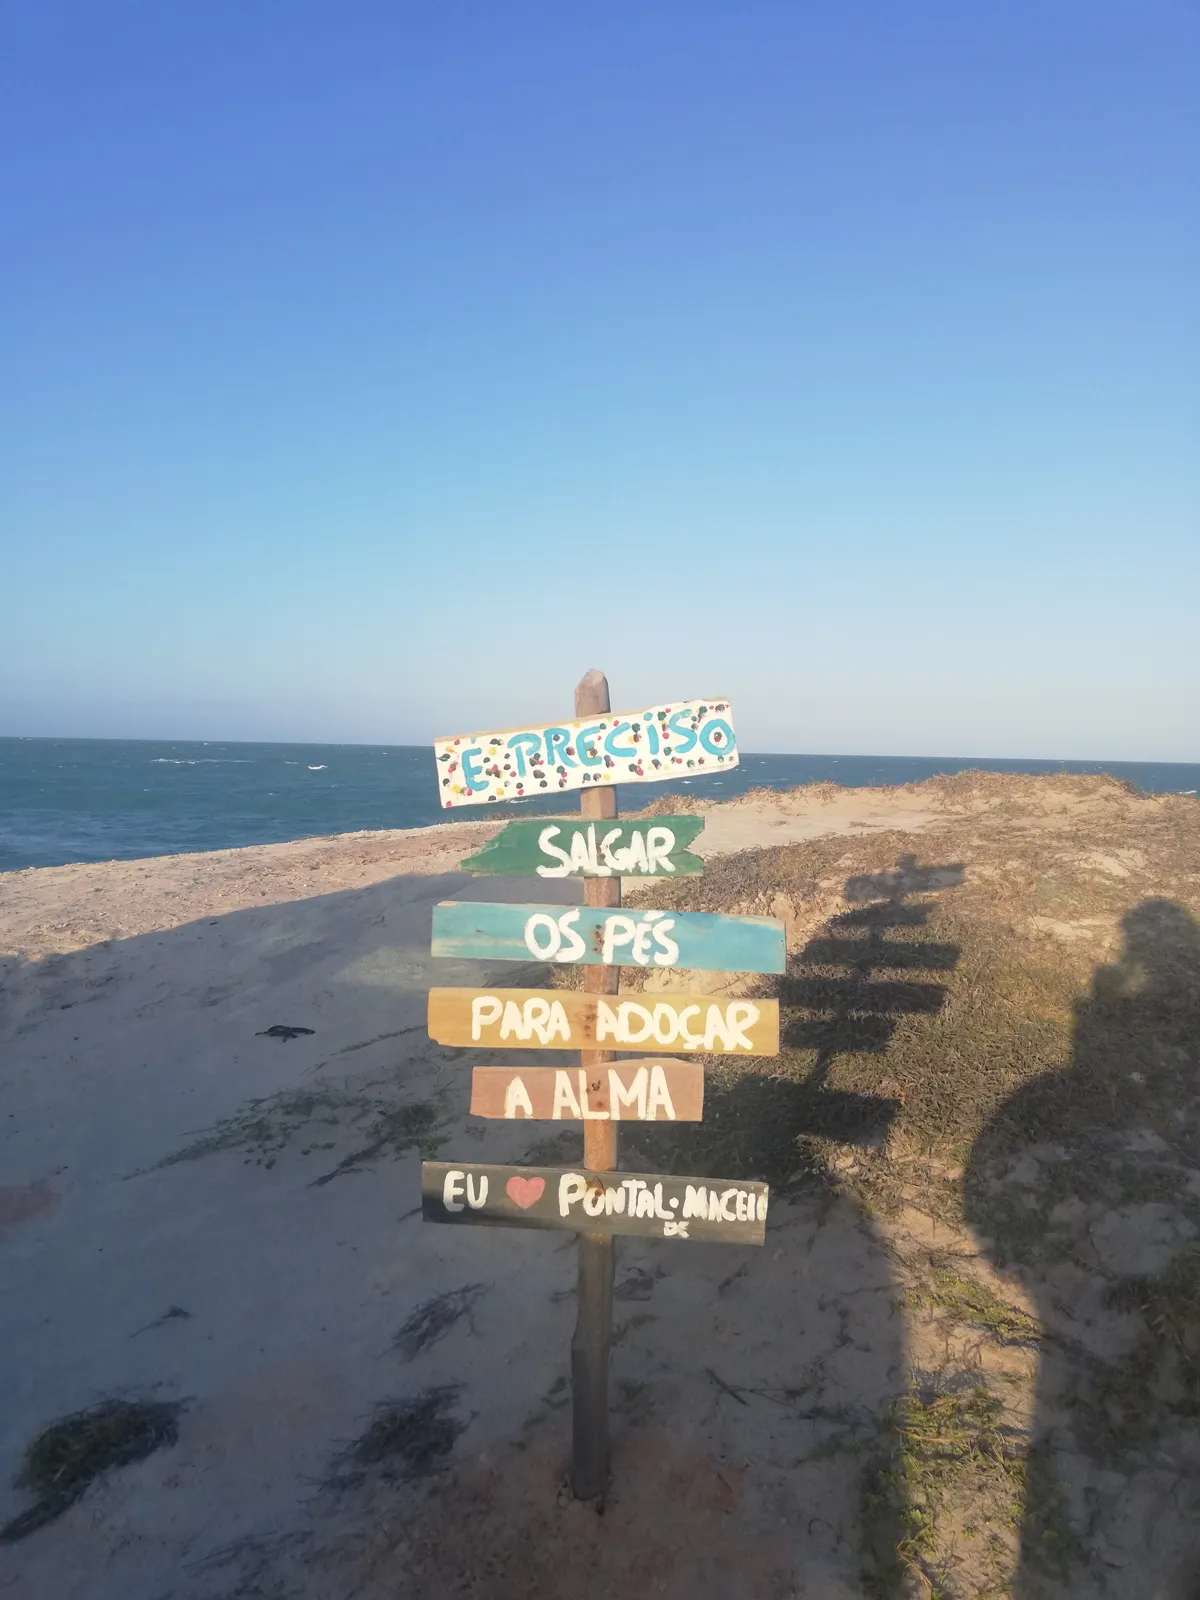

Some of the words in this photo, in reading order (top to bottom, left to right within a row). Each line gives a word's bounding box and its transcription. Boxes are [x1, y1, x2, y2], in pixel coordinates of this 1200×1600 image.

[535, 822, 677, 879] SALGAR
[523, 907, 587, 963] OS
[601, 909, 680, 966] PÉS
[471, 996, 572, 1045] PARA
[596, 999, 761, 1051] ADOÇAR
[504, 1075, 534, 1120] A
[551, 1064, 676, 1121] ALMA
[442, 1170, 490, 1213] EU
[663, 1220, 690, 1239] DE
